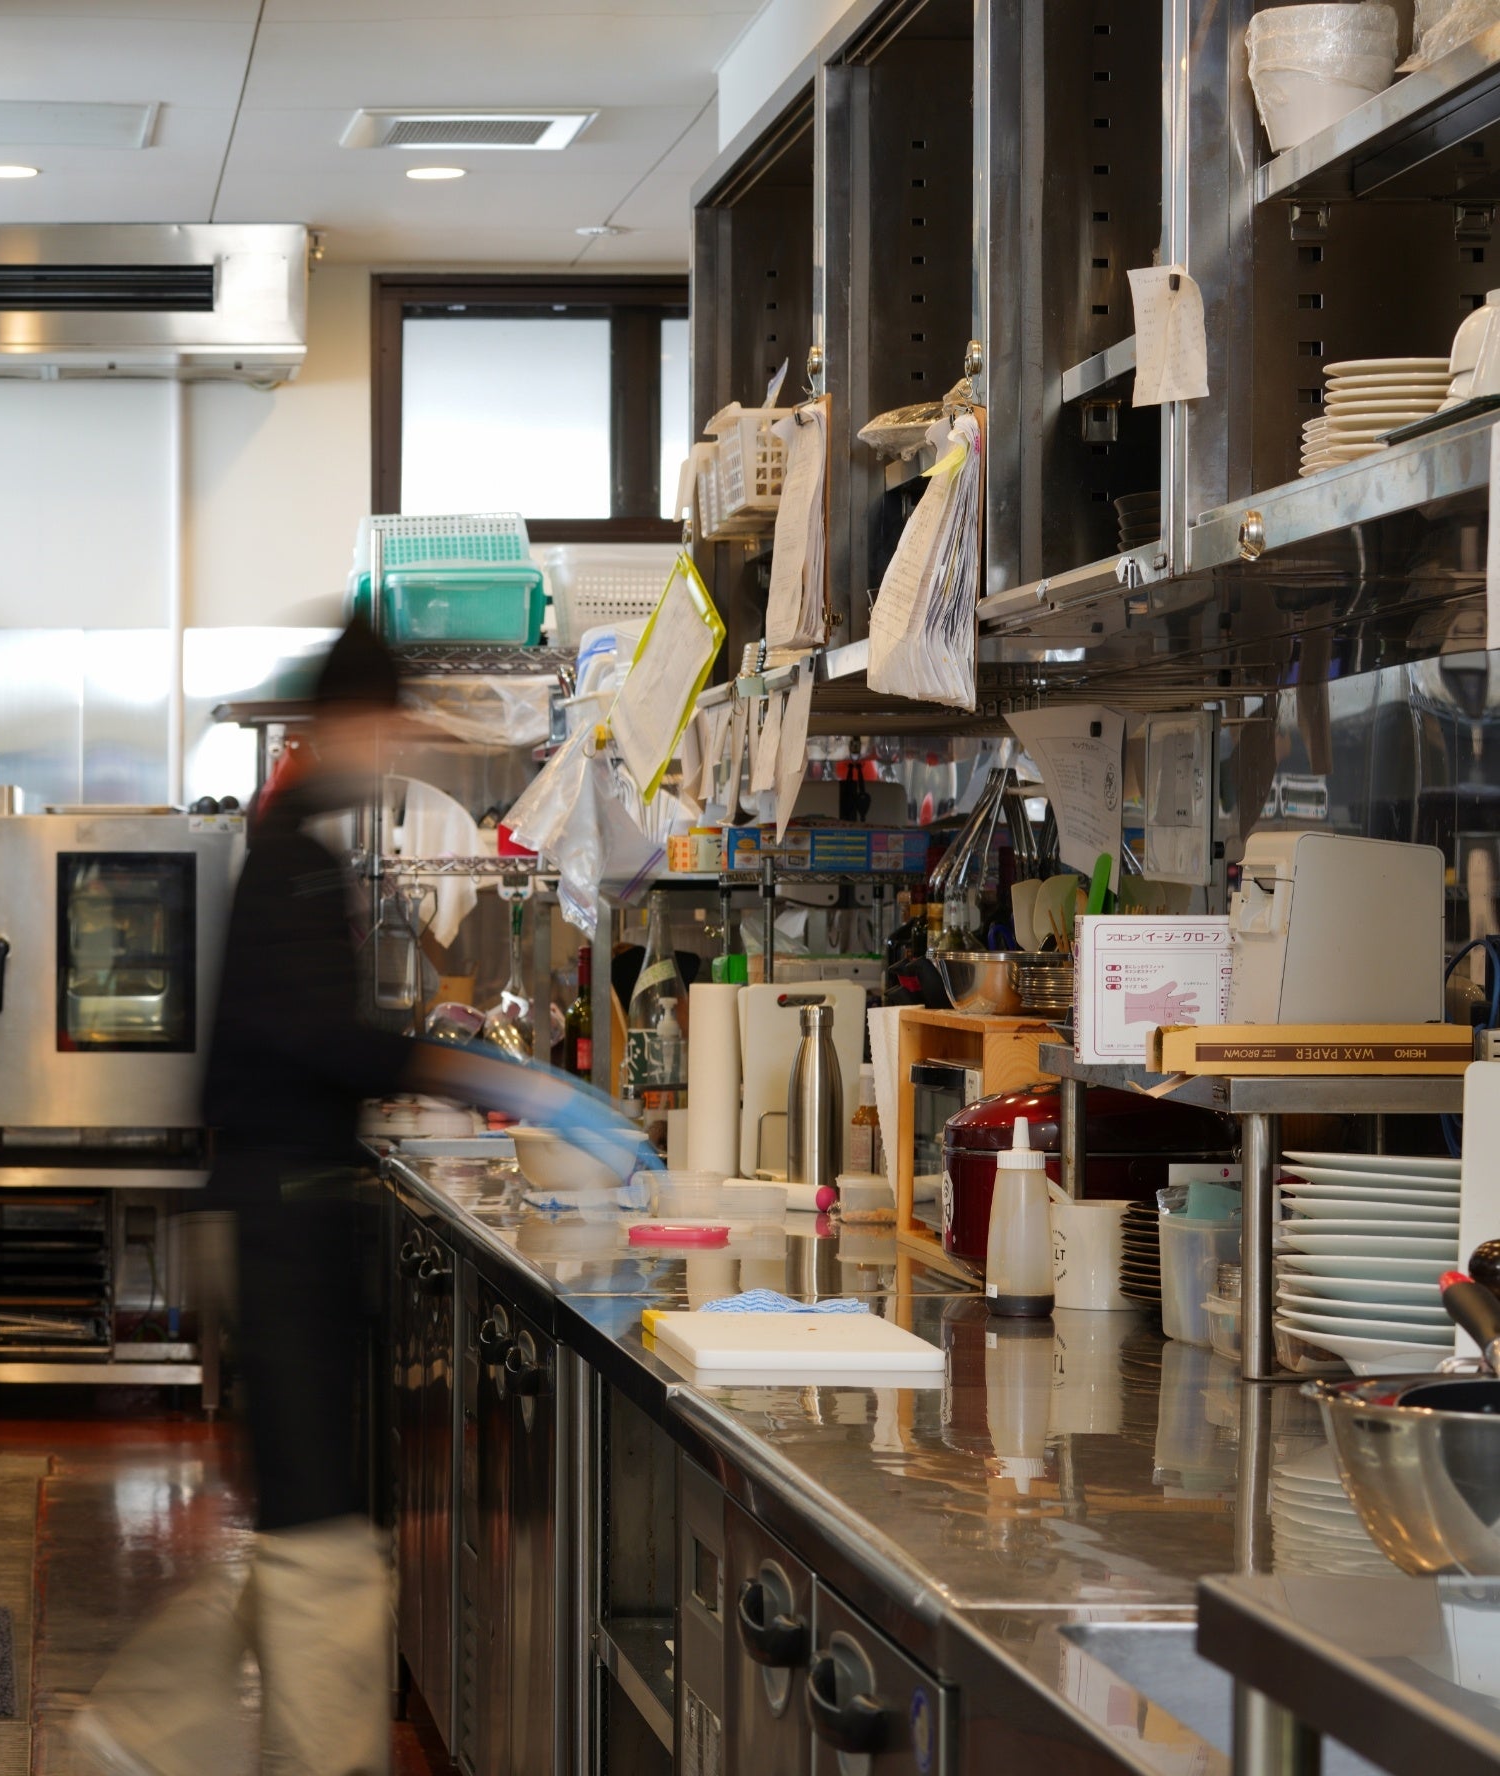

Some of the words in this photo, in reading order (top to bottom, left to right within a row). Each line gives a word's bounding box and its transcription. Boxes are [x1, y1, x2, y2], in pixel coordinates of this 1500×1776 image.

[1224, 1049, 1260, 1058] BROWN
[1296, 1048, 1338, 1060] PAPER
[1344, 1048, 1374, 1060] WAX
